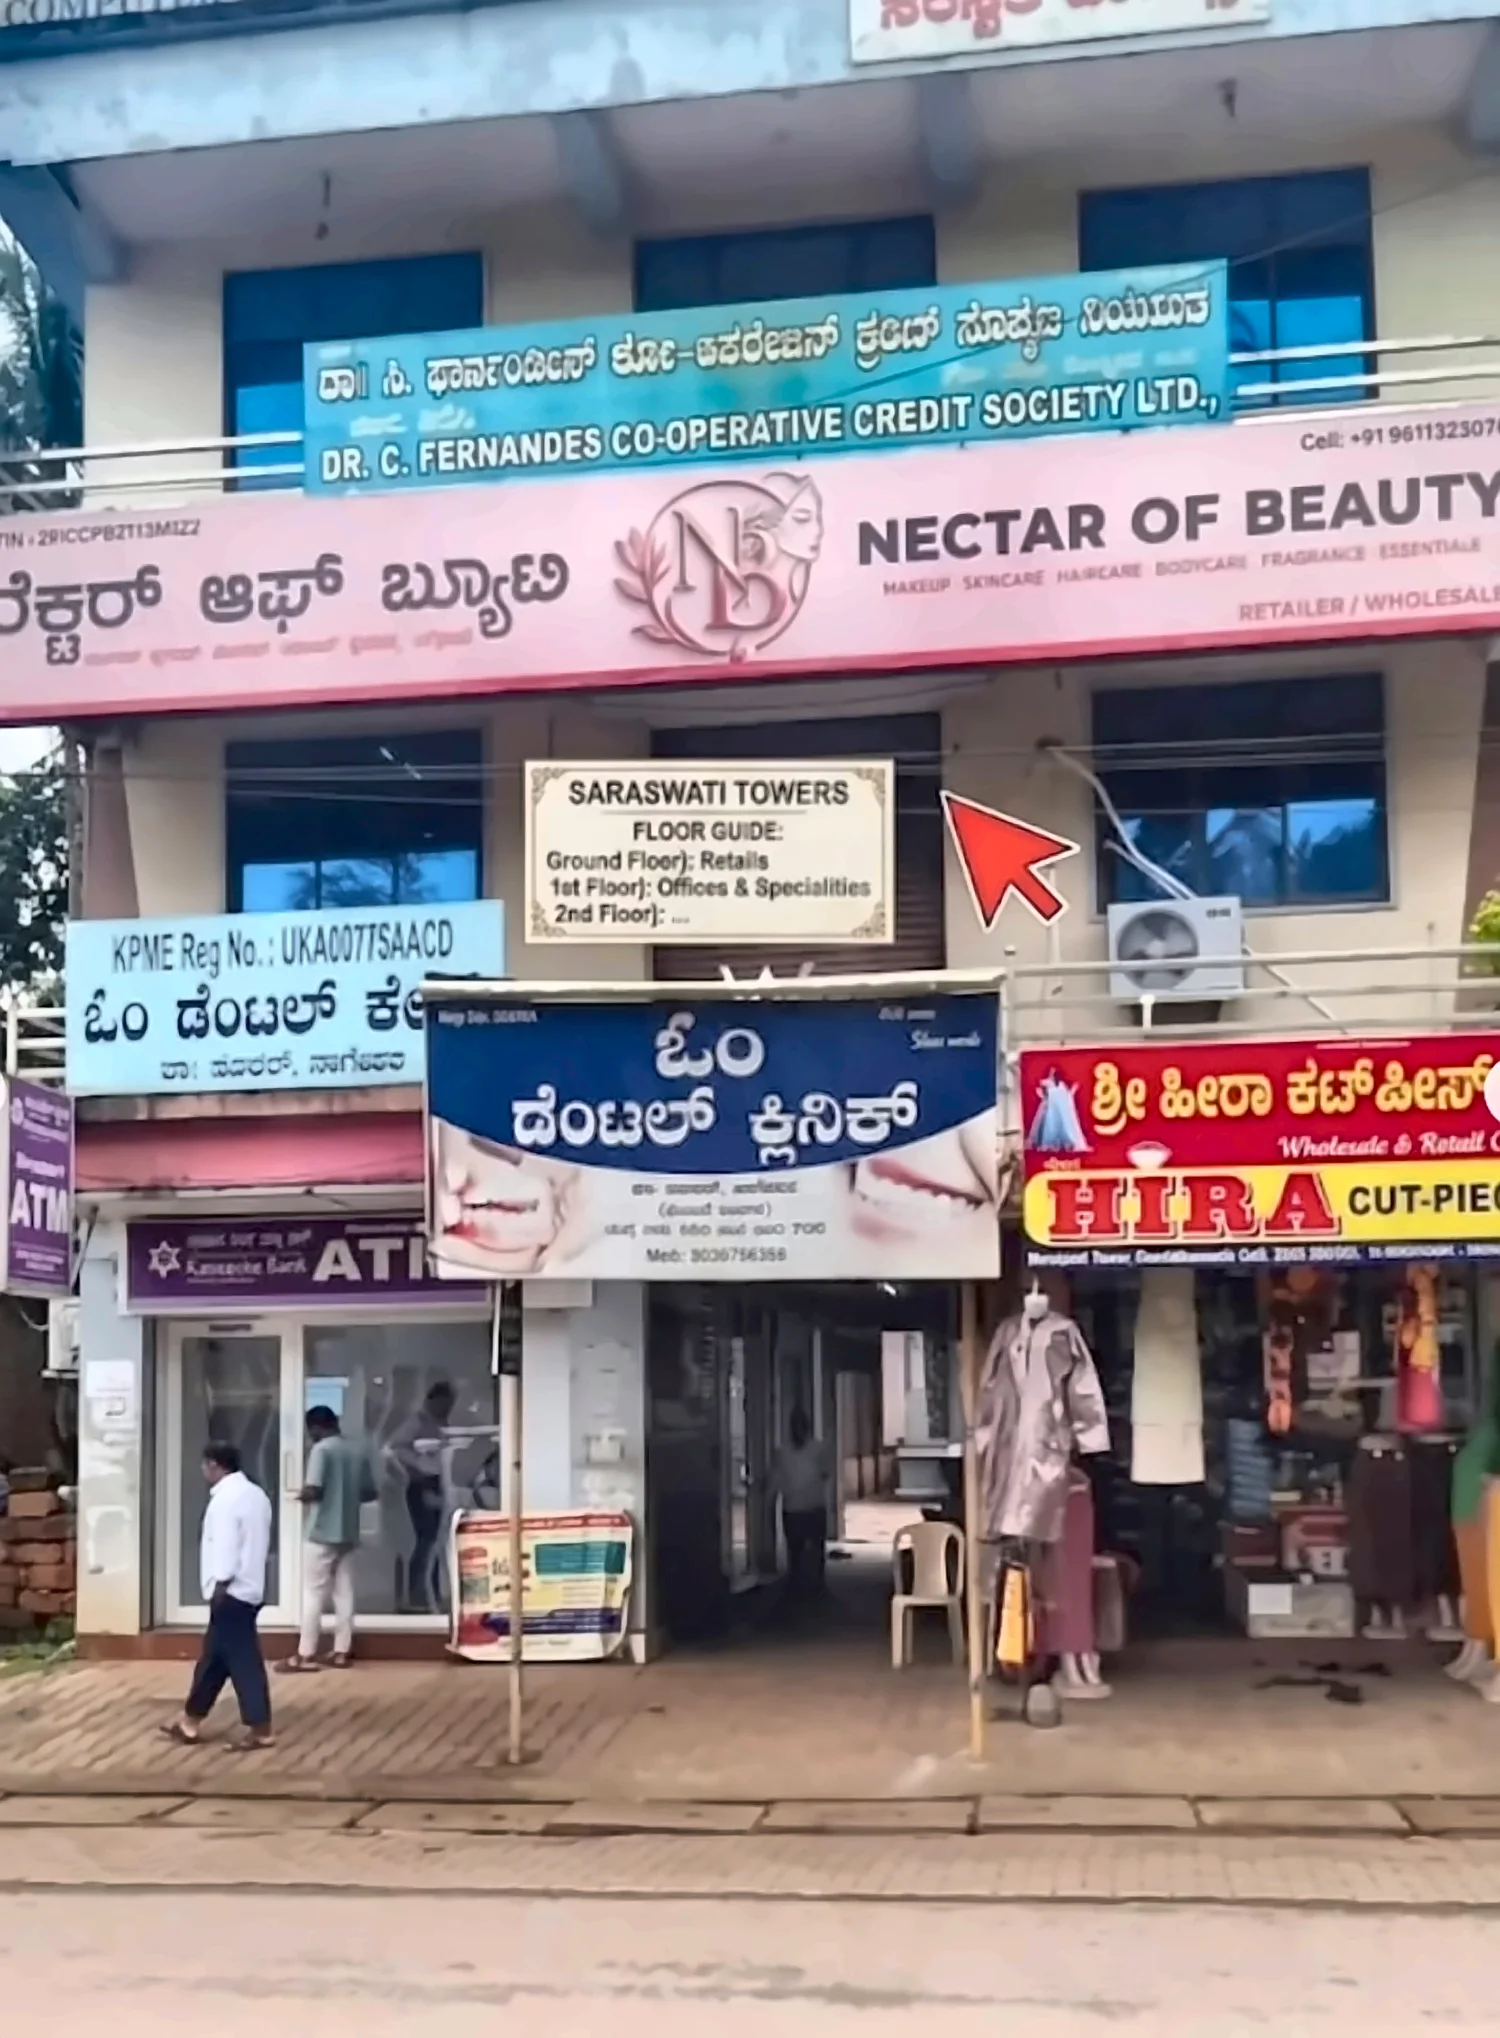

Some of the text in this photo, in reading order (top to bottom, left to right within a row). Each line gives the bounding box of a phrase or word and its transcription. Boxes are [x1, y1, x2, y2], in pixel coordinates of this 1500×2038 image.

[322, 449, 370, 482] DR.
[381, 445, 410, 477] C.
[419, 427, 602, 474] FERNANDES
[611, 406, 843, 456] CO-OPERATIVE
[854, 394, 972, 437] CREDIT
[982, 382, 1126, 426] SOCIETY
[858, 471, 1500, 566] NECTAR OF BEAUTY
[883, 577, 951, 596] MAKEUP
[963, 570, 1046, 590] SKINCARE
[1057, 563, 1143, 584] HAIRCARE
[1261, 545, 1367, 568] FRAGRANCE
[1239, 597, 1345, 622] RETAILER
[567, 779, 850, 806] SARASWATI TOWERS
[632, 820, 784, 842] FLOOR GUIDE:
[546, 850, 622, 871] Ground
[550, 876, 580, 897] 1st
[657, 876, 729, 898] Offices
[733, 877, 750, 898] &
[754, 876, 872, 902] Specialities
[554, 904, 593, 924] 2nd
[112, 933, 173, 973] KPME
[179, 932, 220, 978] Reg
[84, 987, 150, 1044] ಓಂ
[176, 978, 338, 1040] ಡೆಂಟಲ್
[655, 1010, 765, 1078] ಓಂ
[511, 1080, 919, 1167] ಡೆಂಟಲ್ ಕ್ಲಿನಿಕ್
[1091, 1061, 1147, 1136] ಶ್ರೀ
[1158, 1066, 1274, 1118] ಹೀರಾ
[1277, 1134, 1389, 1159] Wholesale
[1418, 1130, 1486, 1155] Retail
[11, 1178, 69, 1234] ATM
[1048, 1172, 1342, 1242] HIRA
